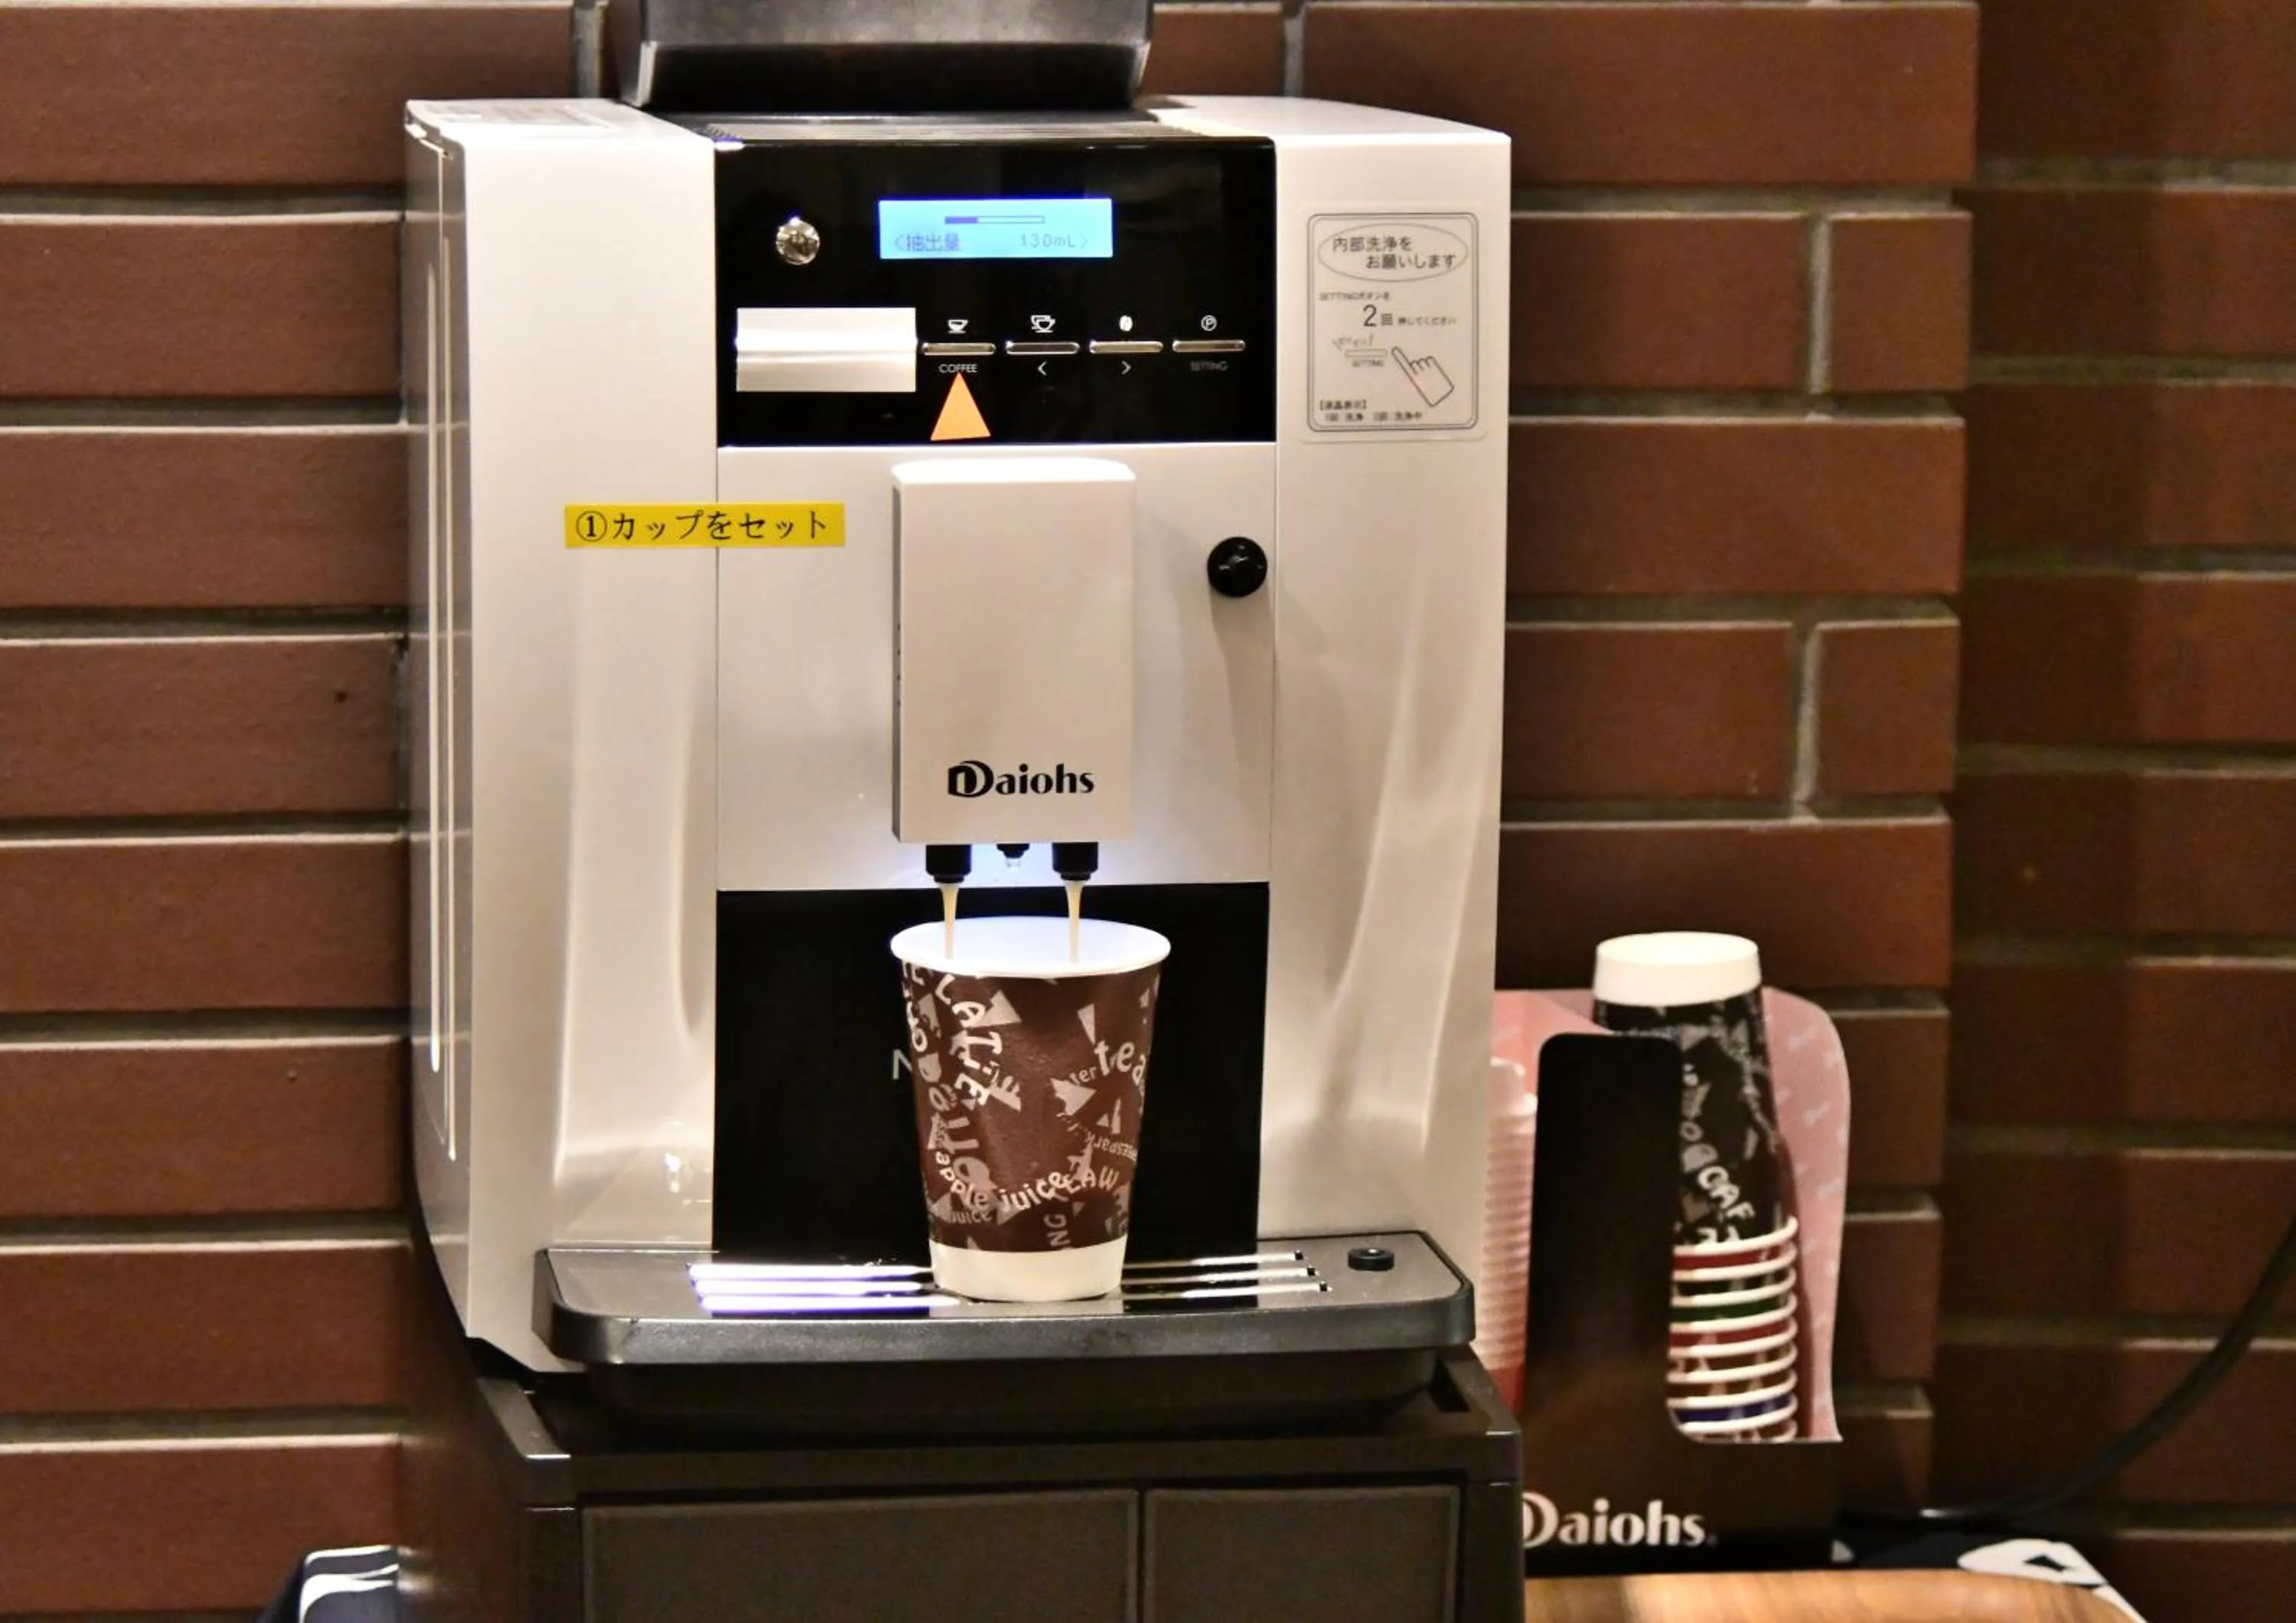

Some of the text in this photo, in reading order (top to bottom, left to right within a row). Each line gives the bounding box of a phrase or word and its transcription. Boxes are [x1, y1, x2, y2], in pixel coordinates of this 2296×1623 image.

[1332, 236, 1413, 253] 内部洗浄を
[1365, 253, 1457, 269] お願いします
[938, 364, 978, 374] COFFEE
[947, 759, 1095, 798] Daiohs
[1523, 1491, 1706, 1550] Daiohs
